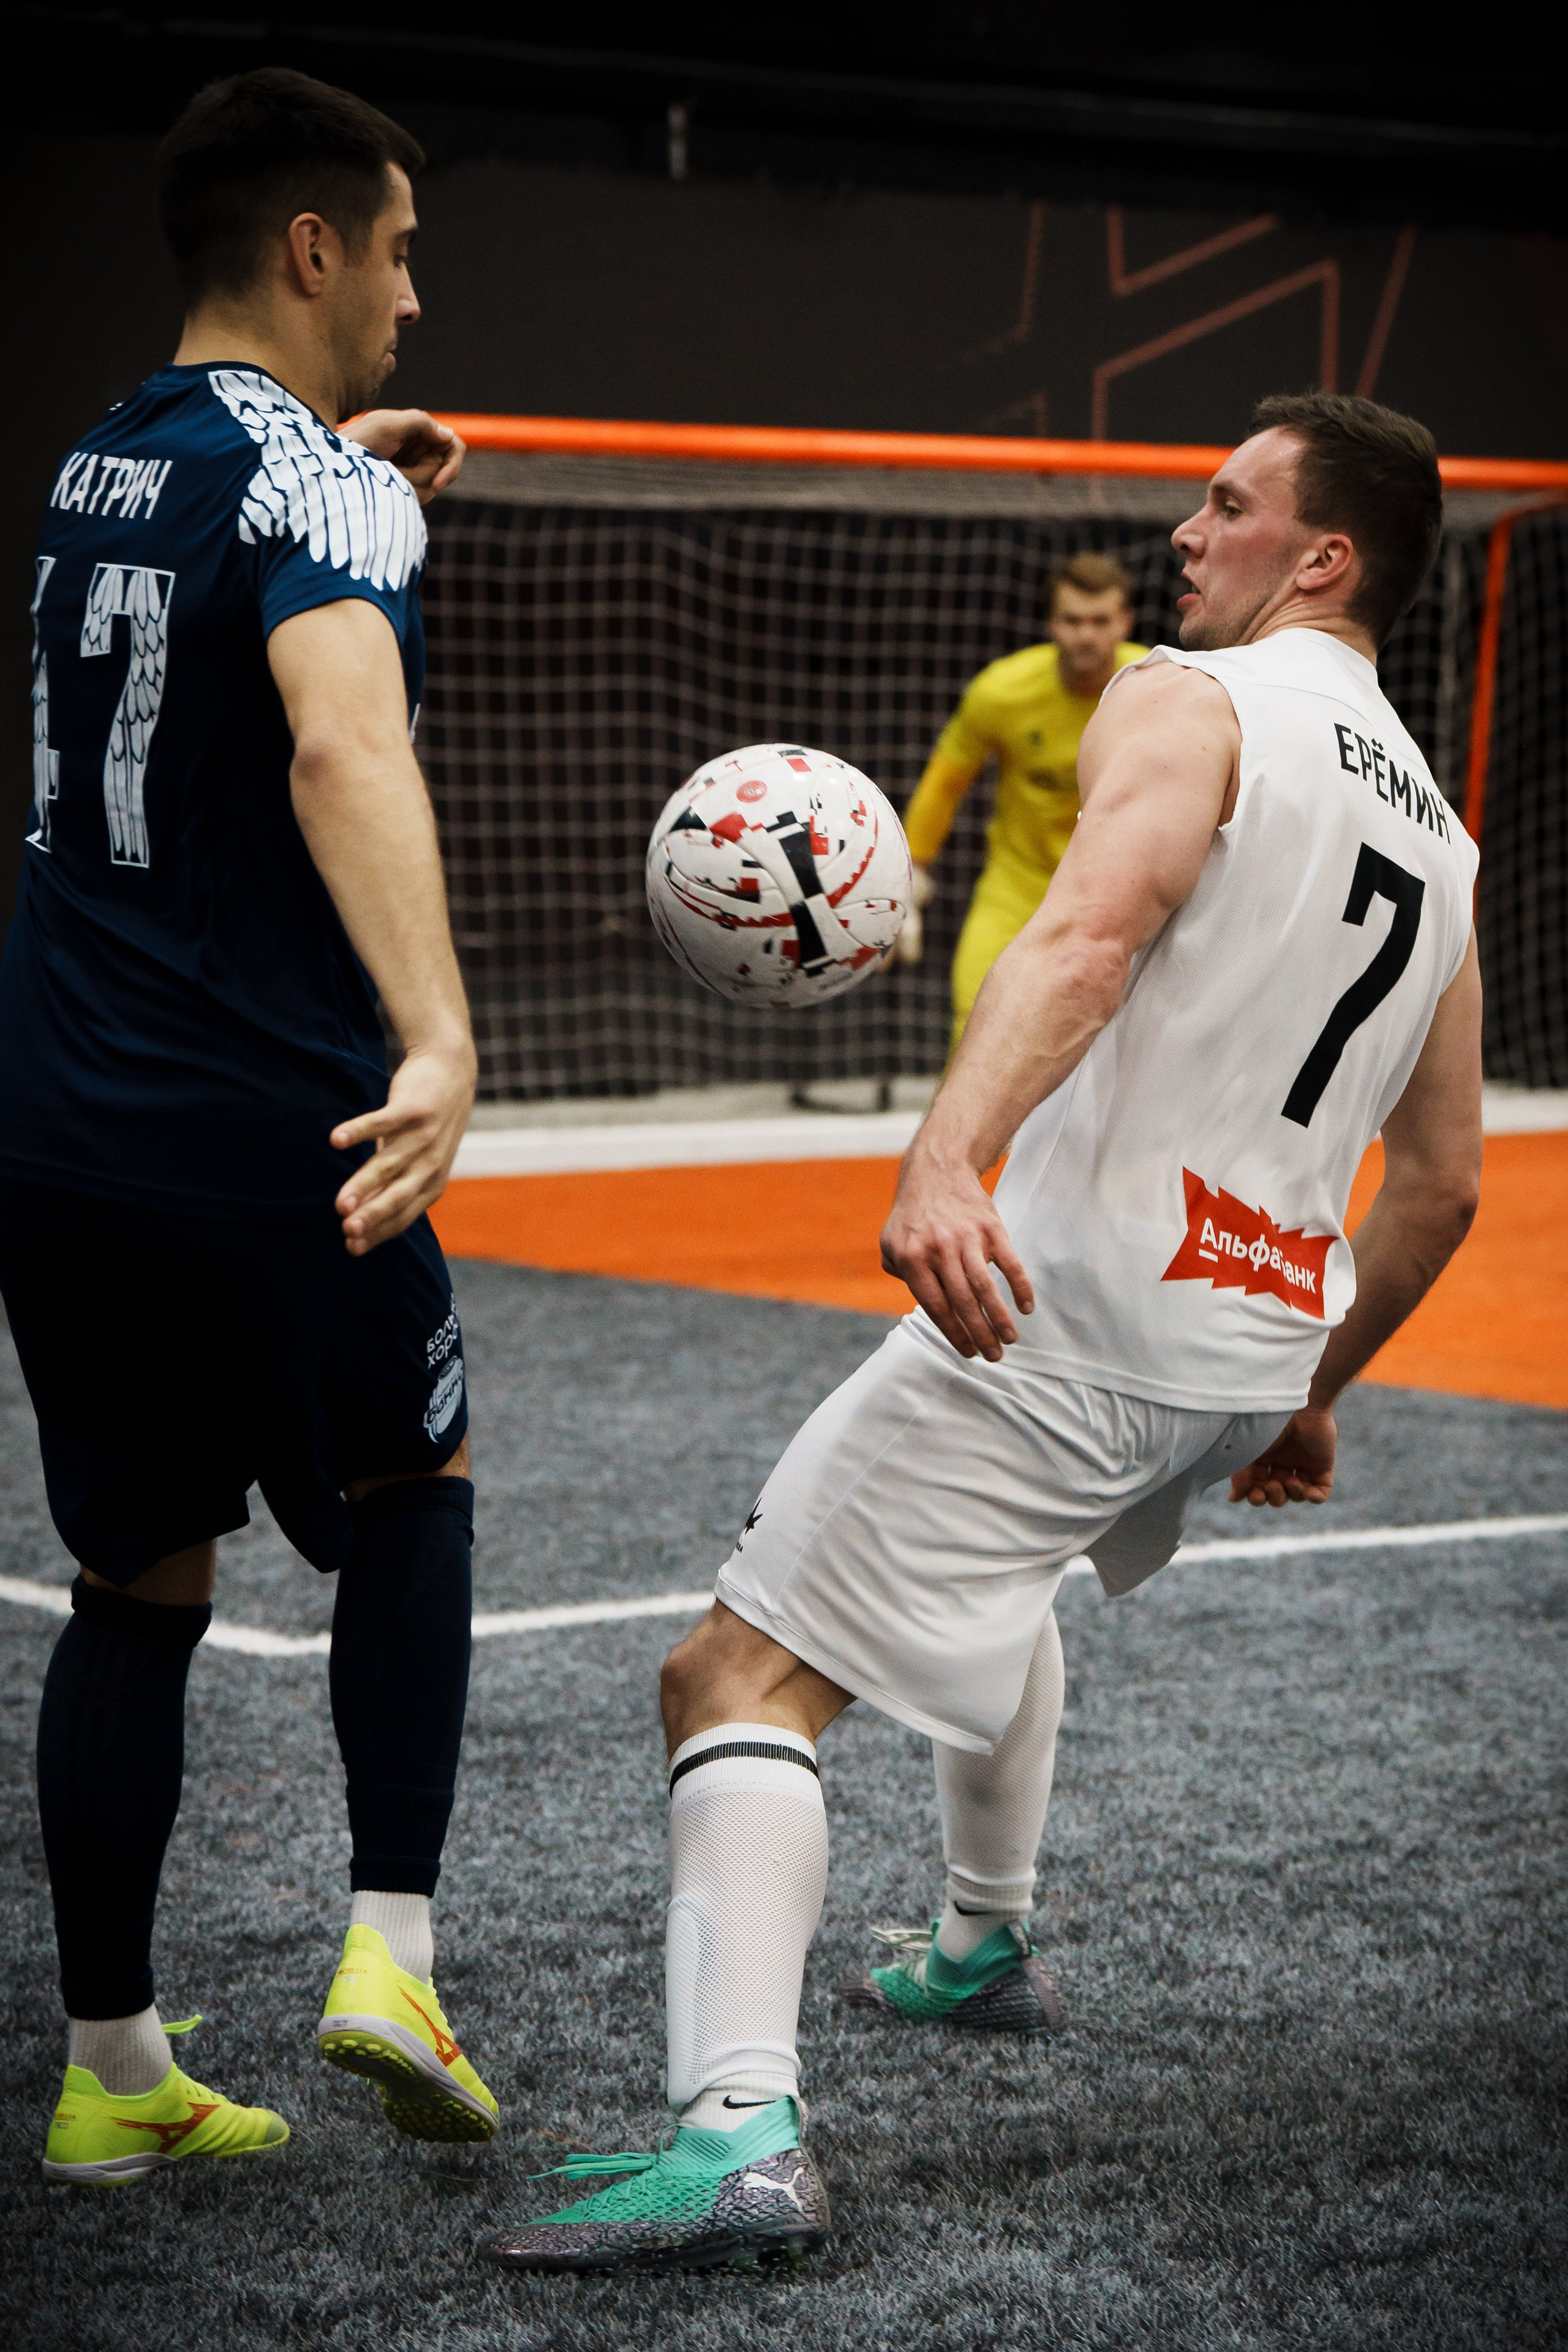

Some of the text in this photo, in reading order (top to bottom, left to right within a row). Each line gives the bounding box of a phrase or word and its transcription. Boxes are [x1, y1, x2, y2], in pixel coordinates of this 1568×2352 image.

[50, 451, 173, 519] КАТРИЧ
[1334, 722, 1451, 845] ЕРЁМИН
[1281, 841, 1426, 1129] 7
